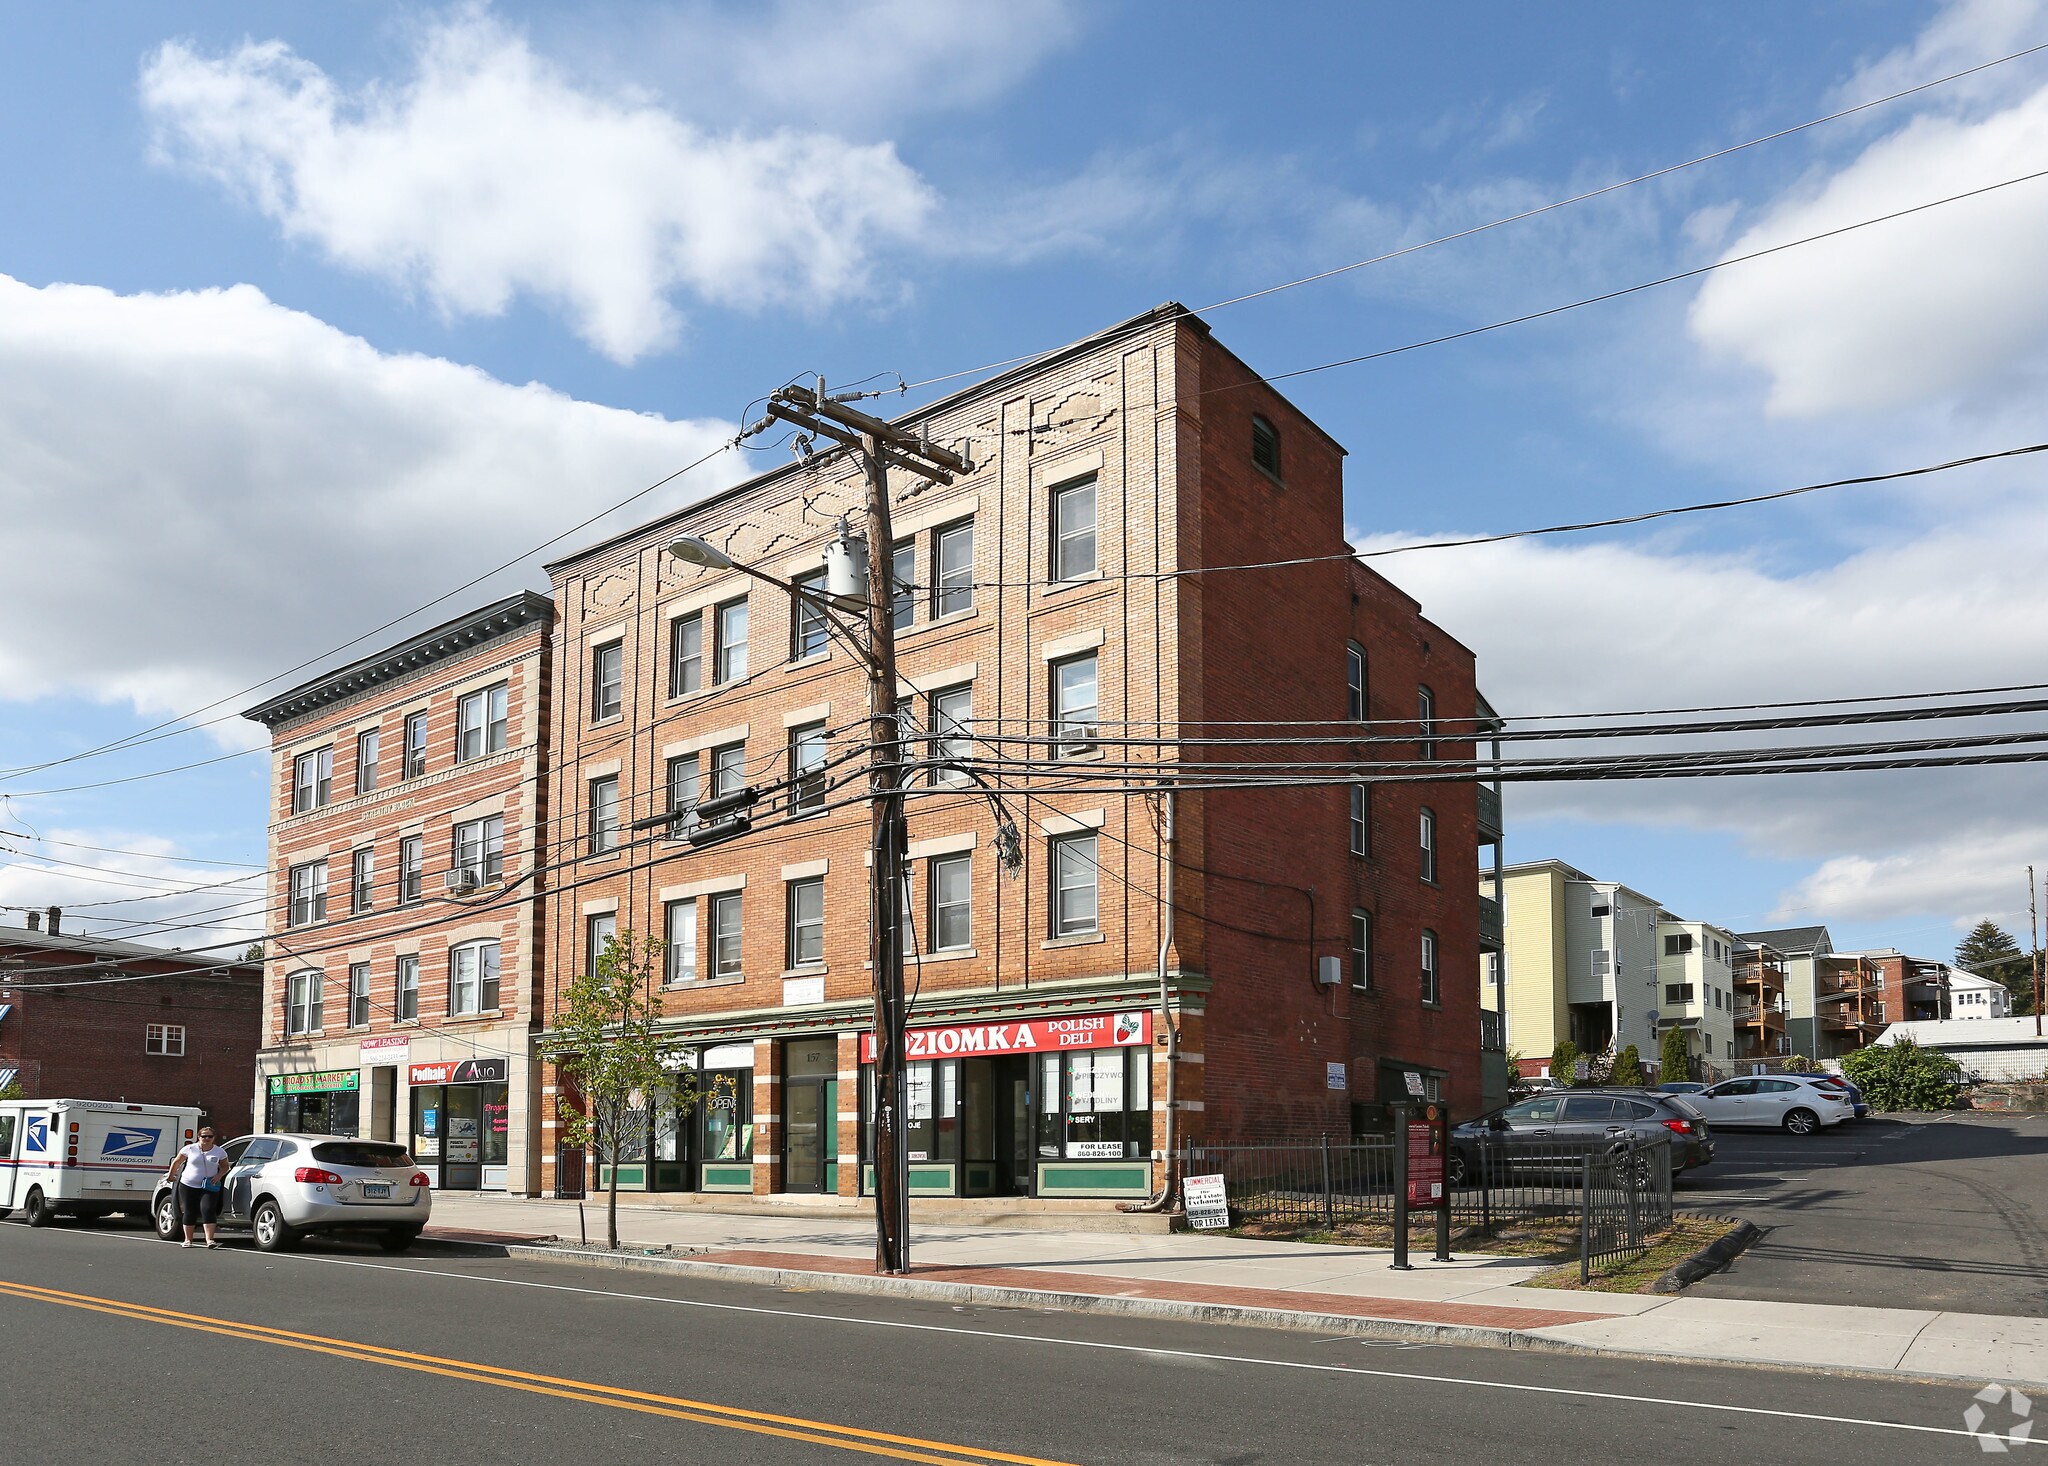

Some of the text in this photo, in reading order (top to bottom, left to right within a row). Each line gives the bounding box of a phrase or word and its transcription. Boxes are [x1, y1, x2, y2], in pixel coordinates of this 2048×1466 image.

[1048, 1017, 1105, 1033] POLISH
[361, 1037, 407, 1049] NOW LEASING
[868, 1023, 1037, 1060] ZIOMKA
[1058, 1031, 1093, 1046] DELI
[283, 1075, 304, 1085] BROAD
[316, 1072, 345, 1083] MARKET
[412, 1066, 447, 1082] Podhale
[77, 1101, 114, 1109] 9200203
[711, 1099, 735, 1110] OPEN
[1075, 1116, 1096, 1124] SERY
[100, 1156, 153, 1164] www.usps.com
[1186, 1176, 1222, 1187] COMMERCIAL
[1190, 1218, 1227, 1227] FOR LEASE
